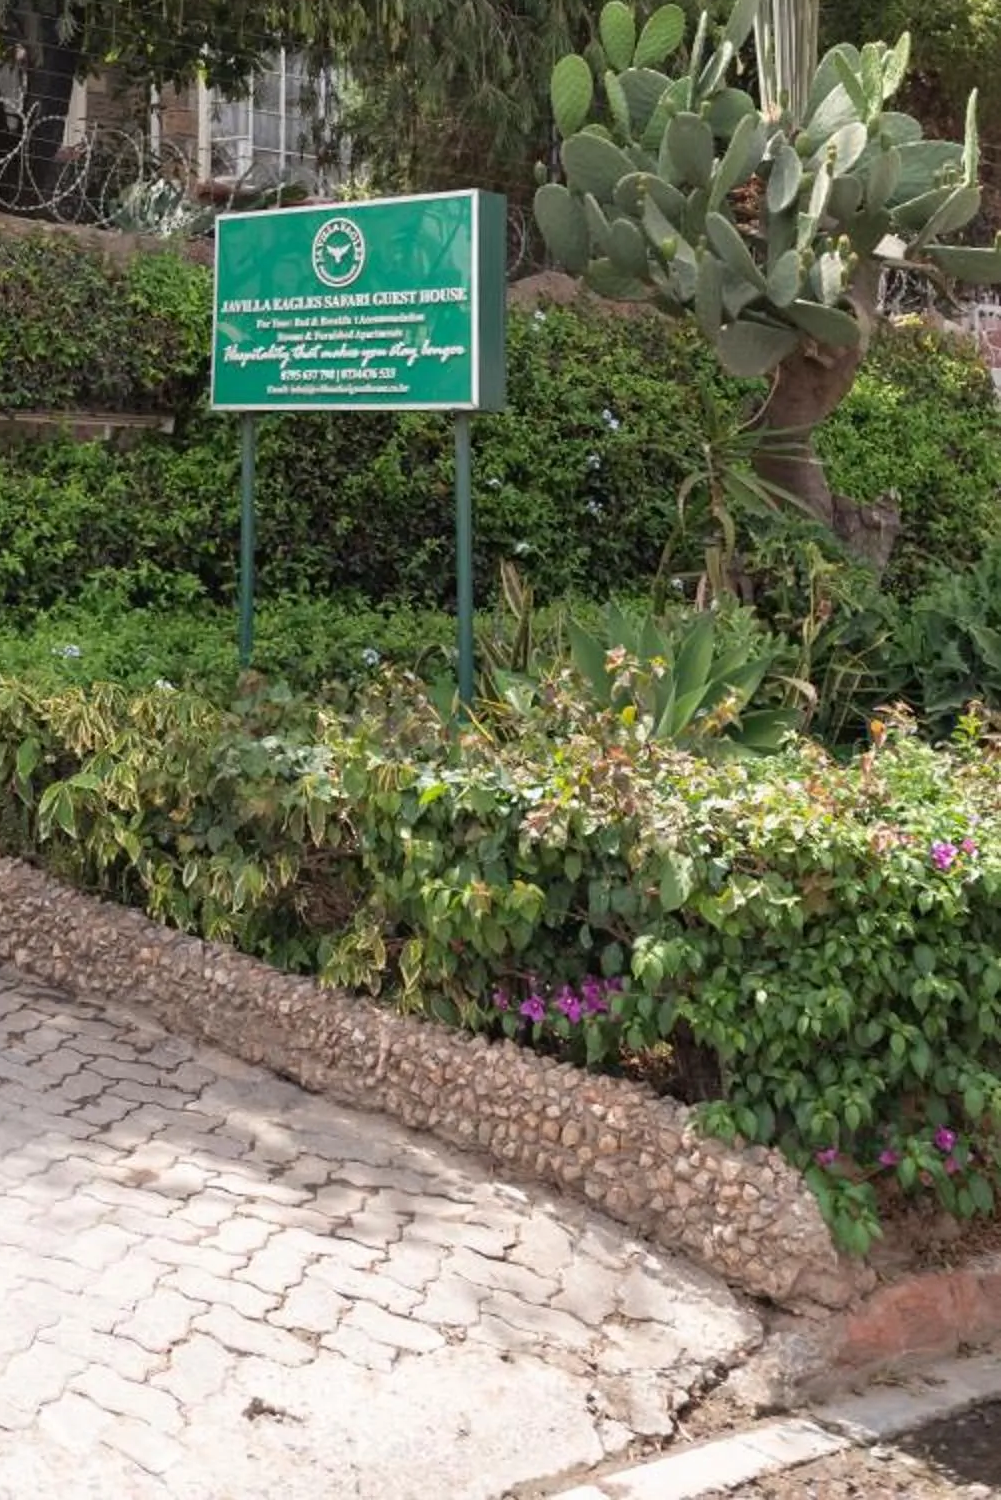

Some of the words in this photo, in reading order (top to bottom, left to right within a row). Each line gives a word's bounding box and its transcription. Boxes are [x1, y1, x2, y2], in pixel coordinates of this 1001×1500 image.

[221, 299, 272, 313] JAVILLA
[273, 297, 322, 311] EAGLES
[324, 293, 370, 309] SAFARI
[373, 291, 417, 306] GUEST
[420, 287, 467, 303] HOUSE
[223, 343, 290, 368] Hospitality
[290, 343, 323, 360] that
[360, 349, 388, 367] you
[388, 341, 420, 367] stay
